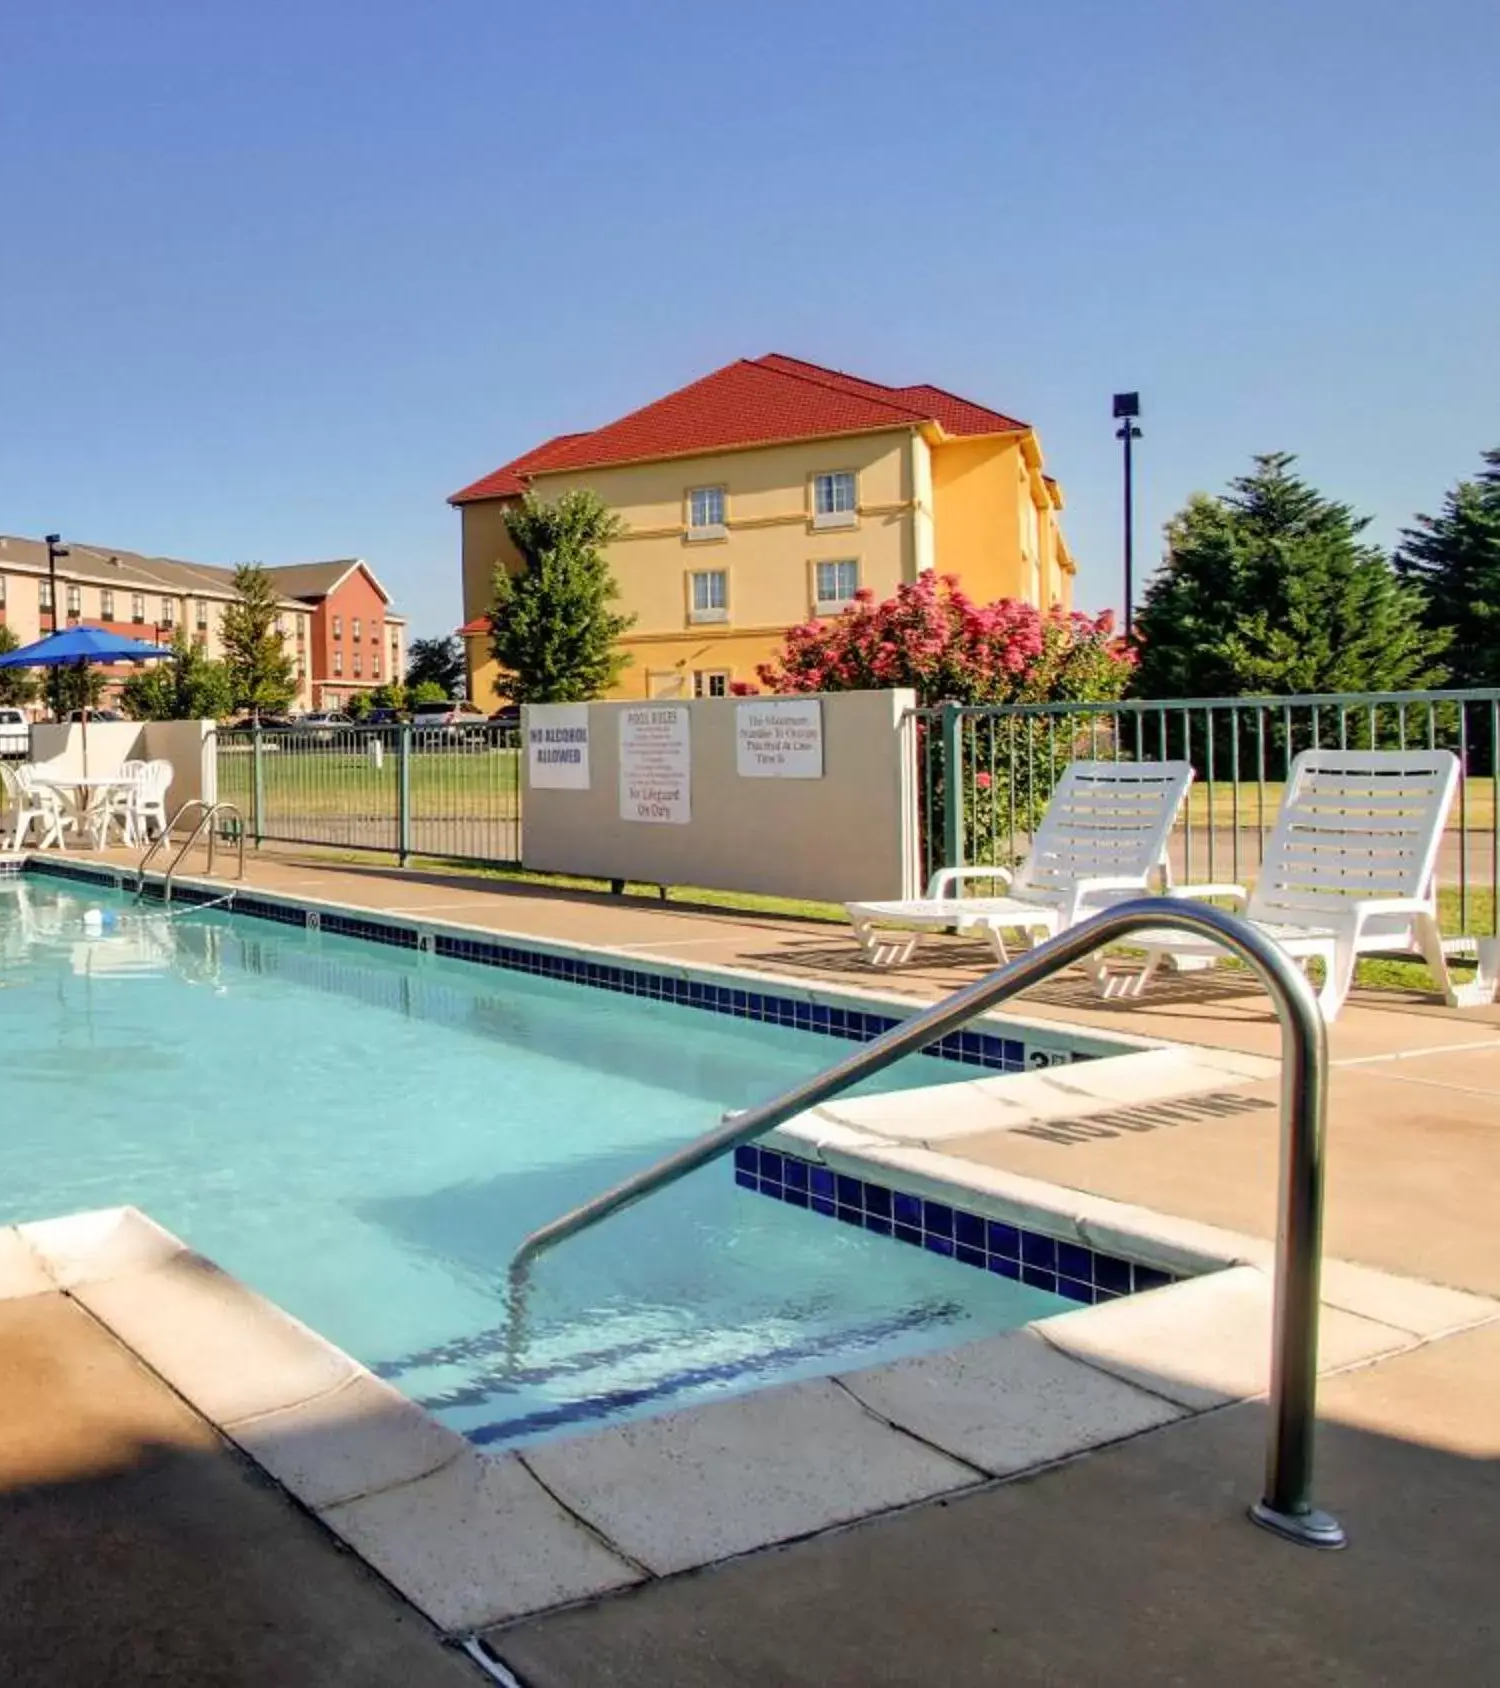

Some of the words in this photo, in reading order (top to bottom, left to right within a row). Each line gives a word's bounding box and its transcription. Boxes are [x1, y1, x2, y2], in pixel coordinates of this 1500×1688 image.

[530, 729, 543, 743] NO
[545, 728, 587, 743] ALCOHOL
[537, 749, 581, 764] ALLOWED
[1007, 1119, 1122, 1146] NO
